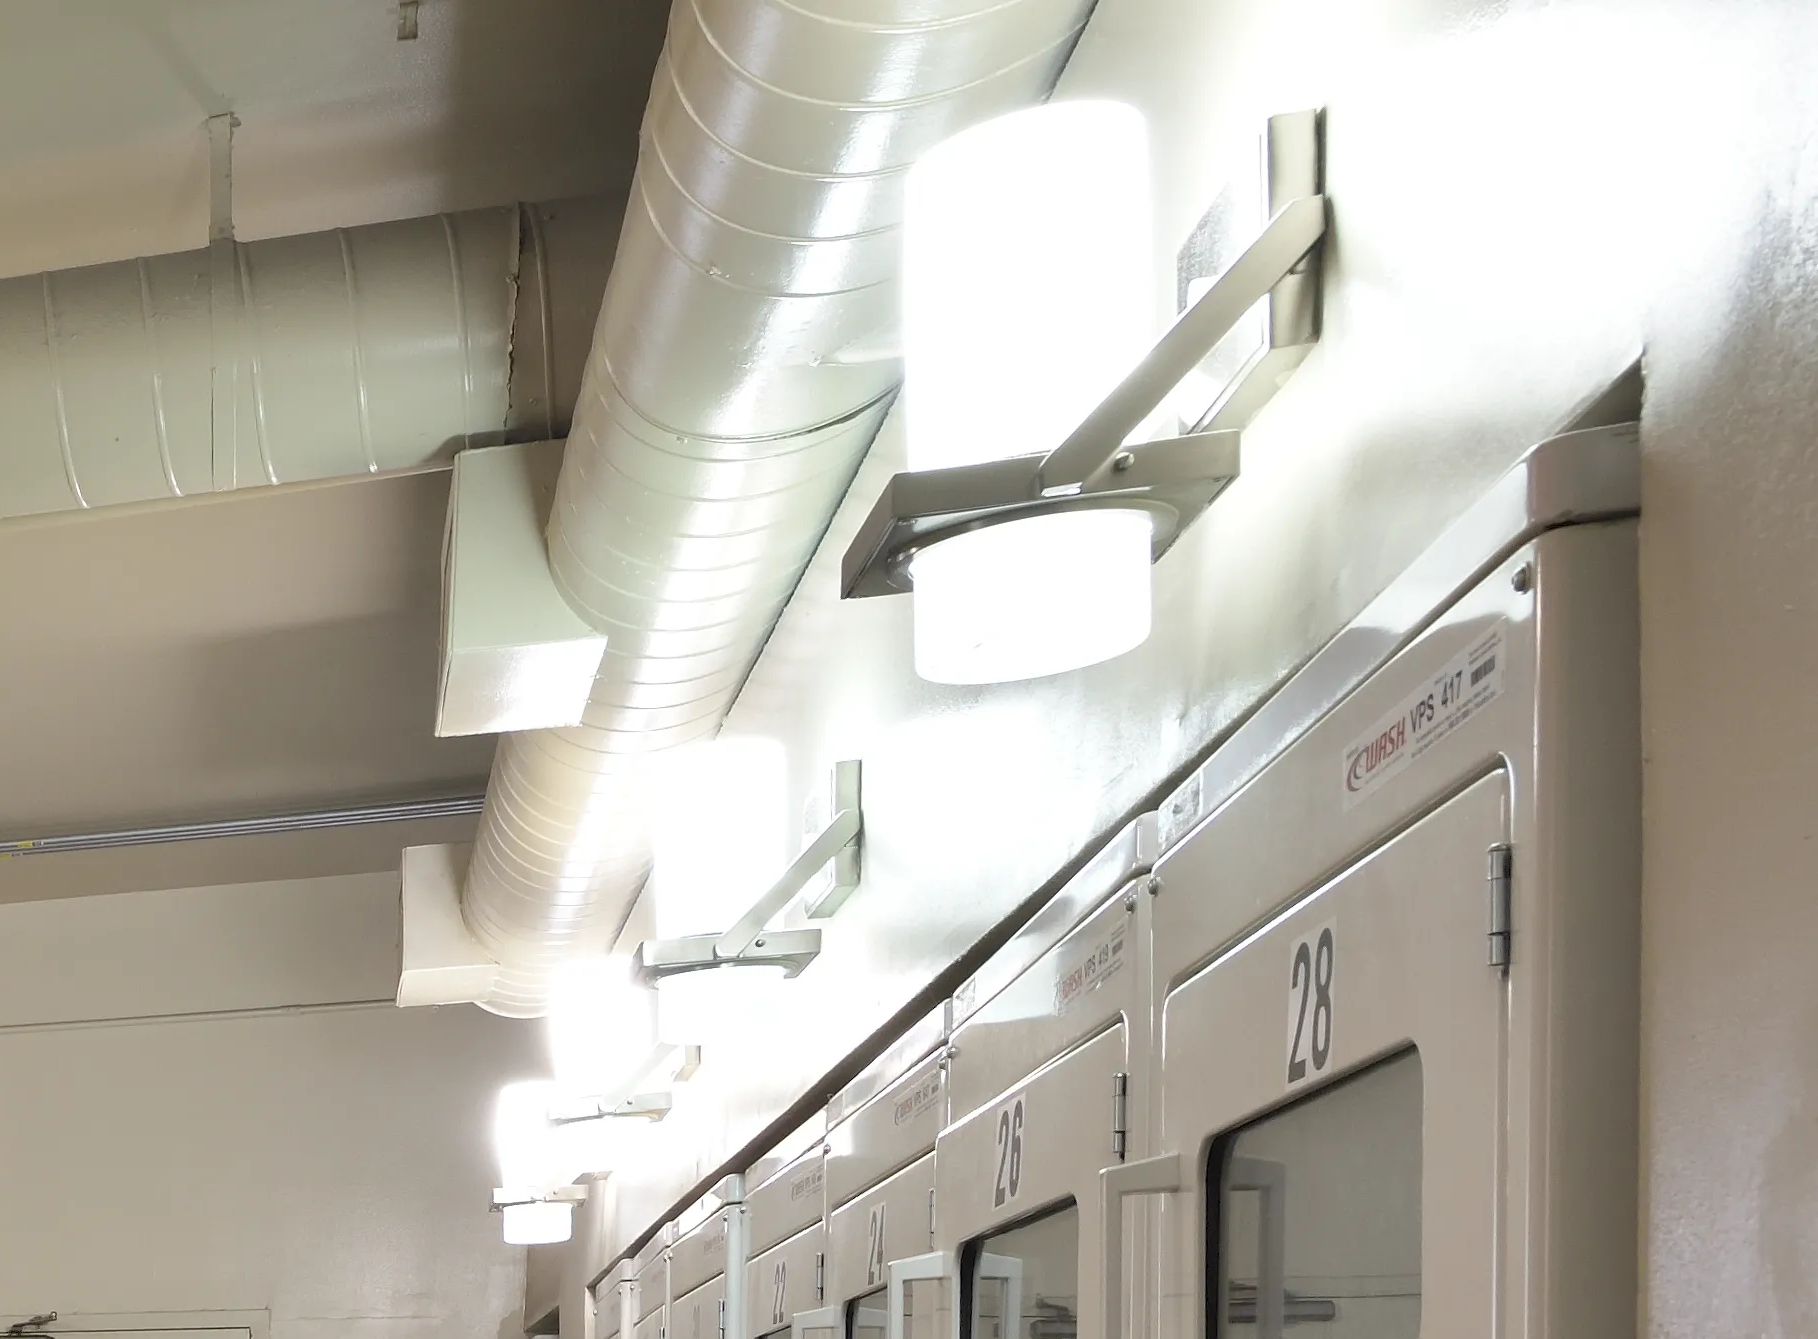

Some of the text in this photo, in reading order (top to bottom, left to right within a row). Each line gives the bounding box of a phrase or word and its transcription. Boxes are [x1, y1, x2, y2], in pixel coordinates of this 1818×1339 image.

[1410, 693, 1435, 733] VPS
[1441, 670, 1463, 708] 417
[1287, 927, 1334, 1084] 28
[994, 1099, 1024, 1208] 26
[868, 1204, 886, 1286] 24
[773, 1261, 786, 1325] 22
